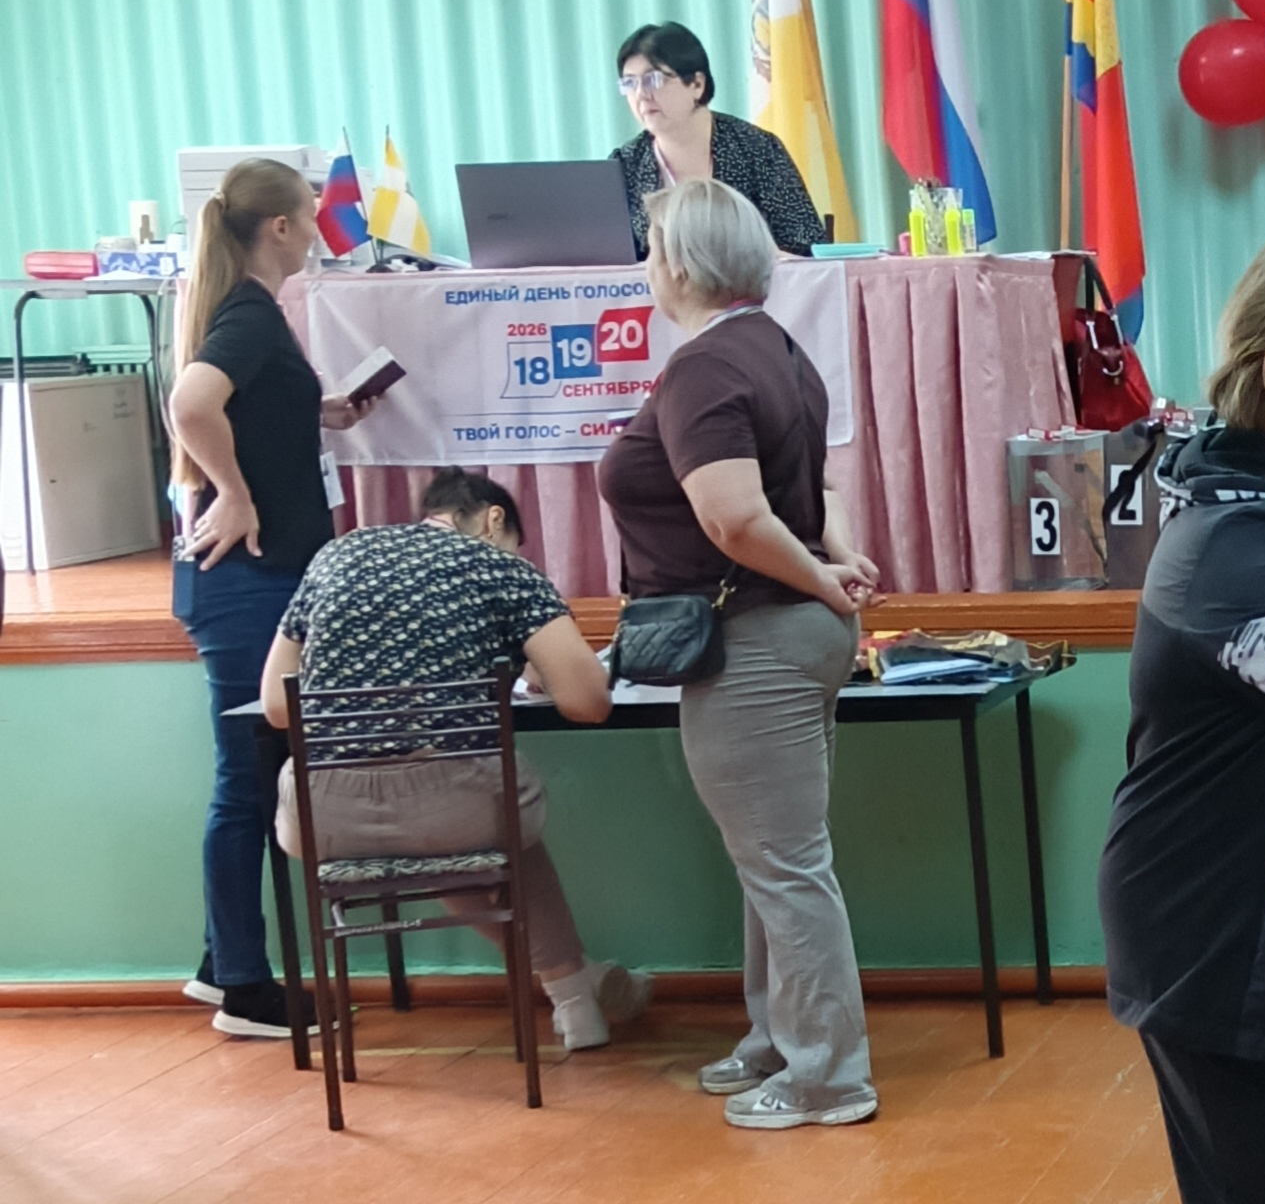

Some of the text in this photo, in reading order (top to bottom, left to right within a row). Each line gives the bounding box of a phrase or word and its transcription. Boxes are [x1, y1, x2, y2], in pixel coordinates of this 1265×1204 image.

[445, 285, 519, 305] ЕДИНЫЙ
[523, 285, 571, 303] ДЕНЬ
[507, 323, 547, 337] 2026
[514, 318, 644, 385] 18 19 20
[562, 380, 652, 397] СЕНТЯБРЯ
[452, 424, 500, 441] ТВОЙ
[505, 424, 561, 439] ГОЛОС
[1035, 500, 1058, 552] 3
